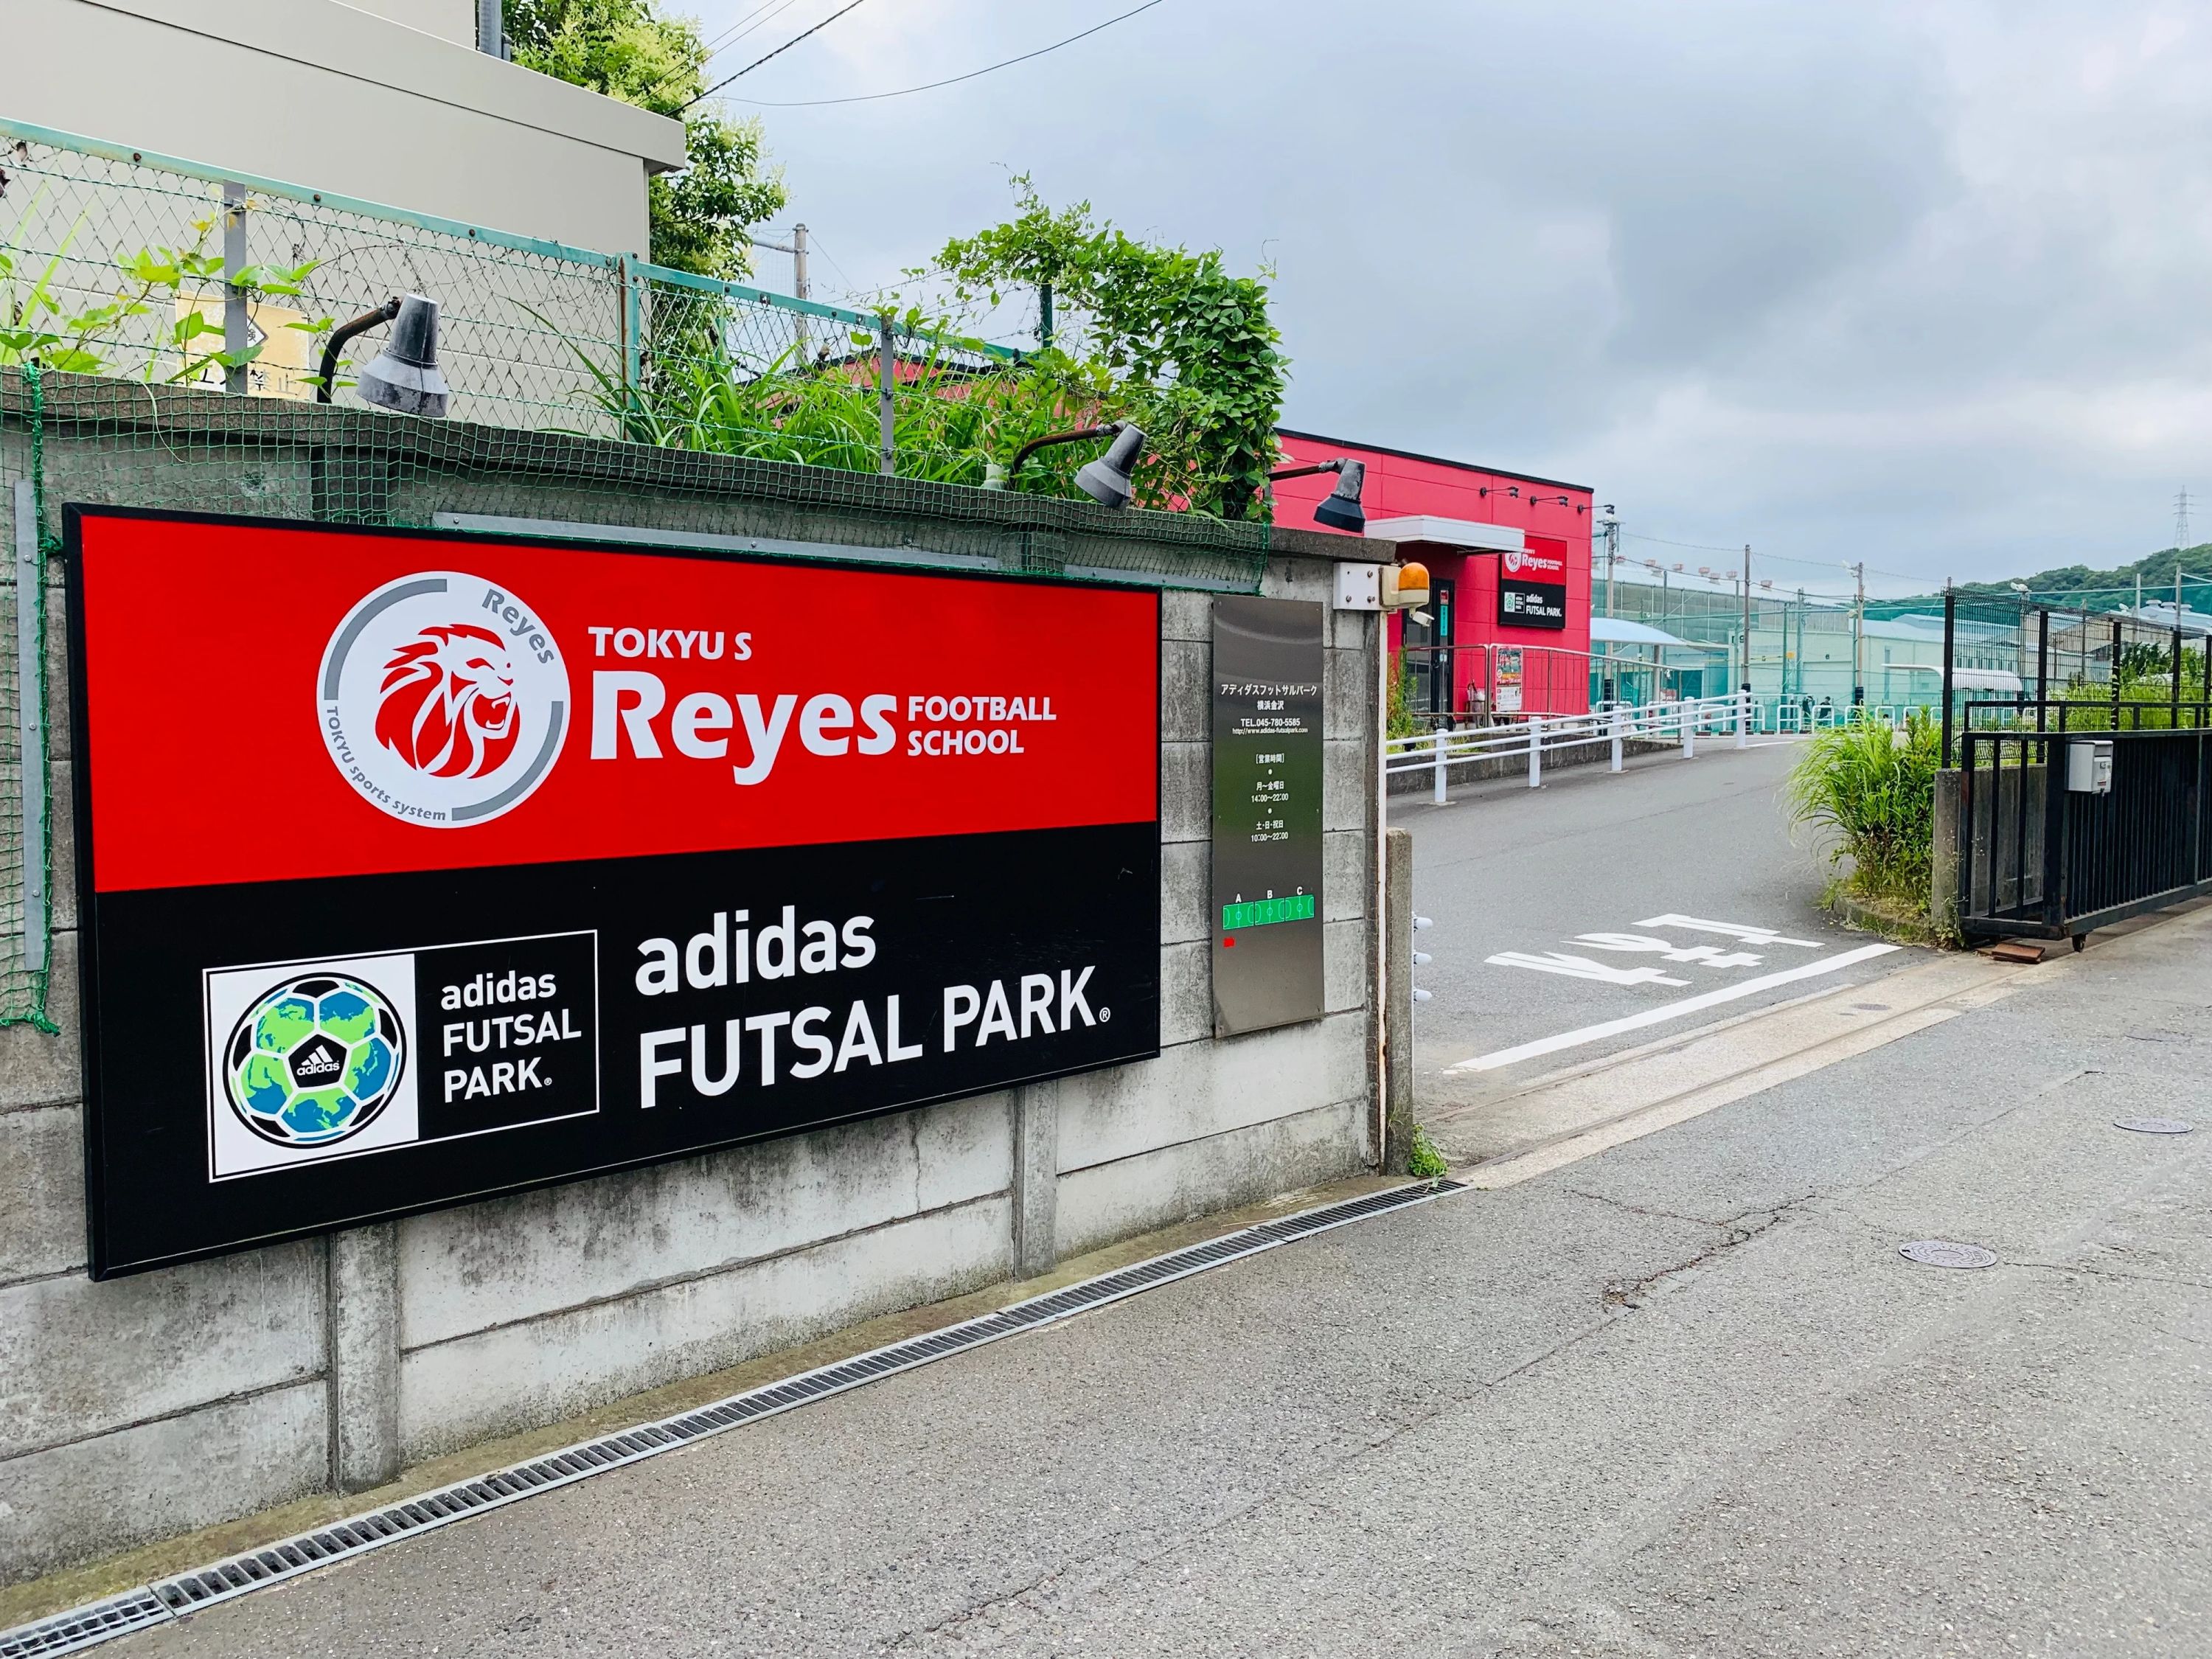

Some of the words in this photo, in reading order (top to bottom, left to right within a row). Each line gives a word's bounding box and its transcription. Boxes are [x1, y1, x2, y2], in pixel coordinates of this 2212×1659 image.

[1521, 554, 1548, 571] Reyes
[1526, 593, 1543, 604] adidas
[1526, 605, 1546, 616] FUTSAL
[481, 588, 554, 664] Reyes
[588, 626, 725, 660] TOKYU
[734, 632, 752, 661] S
[907, 695, 1057, 722] FOOTBALL
[1256, 700, 1284, 711] 横浜金沢
[591, 670, 897, 785] Reyes
[907, 729, 1024, 756] SCHOOL
[327, 706, 355, 764] TOKYU
[349, 765, 391, 804] sports
[392, 799, 446, 821] system
[1235, 894, 1242, 903] A
[1267, 890, 1273, 899] B
[1296, 886, 1303, 895] C
[636, 905, 876, 995] adidas
[441, 970, 557, 1010] adidas
[442, 1008, 582, 1057] FUTSAL
[640, 994, 923, 1109] FUTSAL
[296, 1062, 340, 1076] adidas
